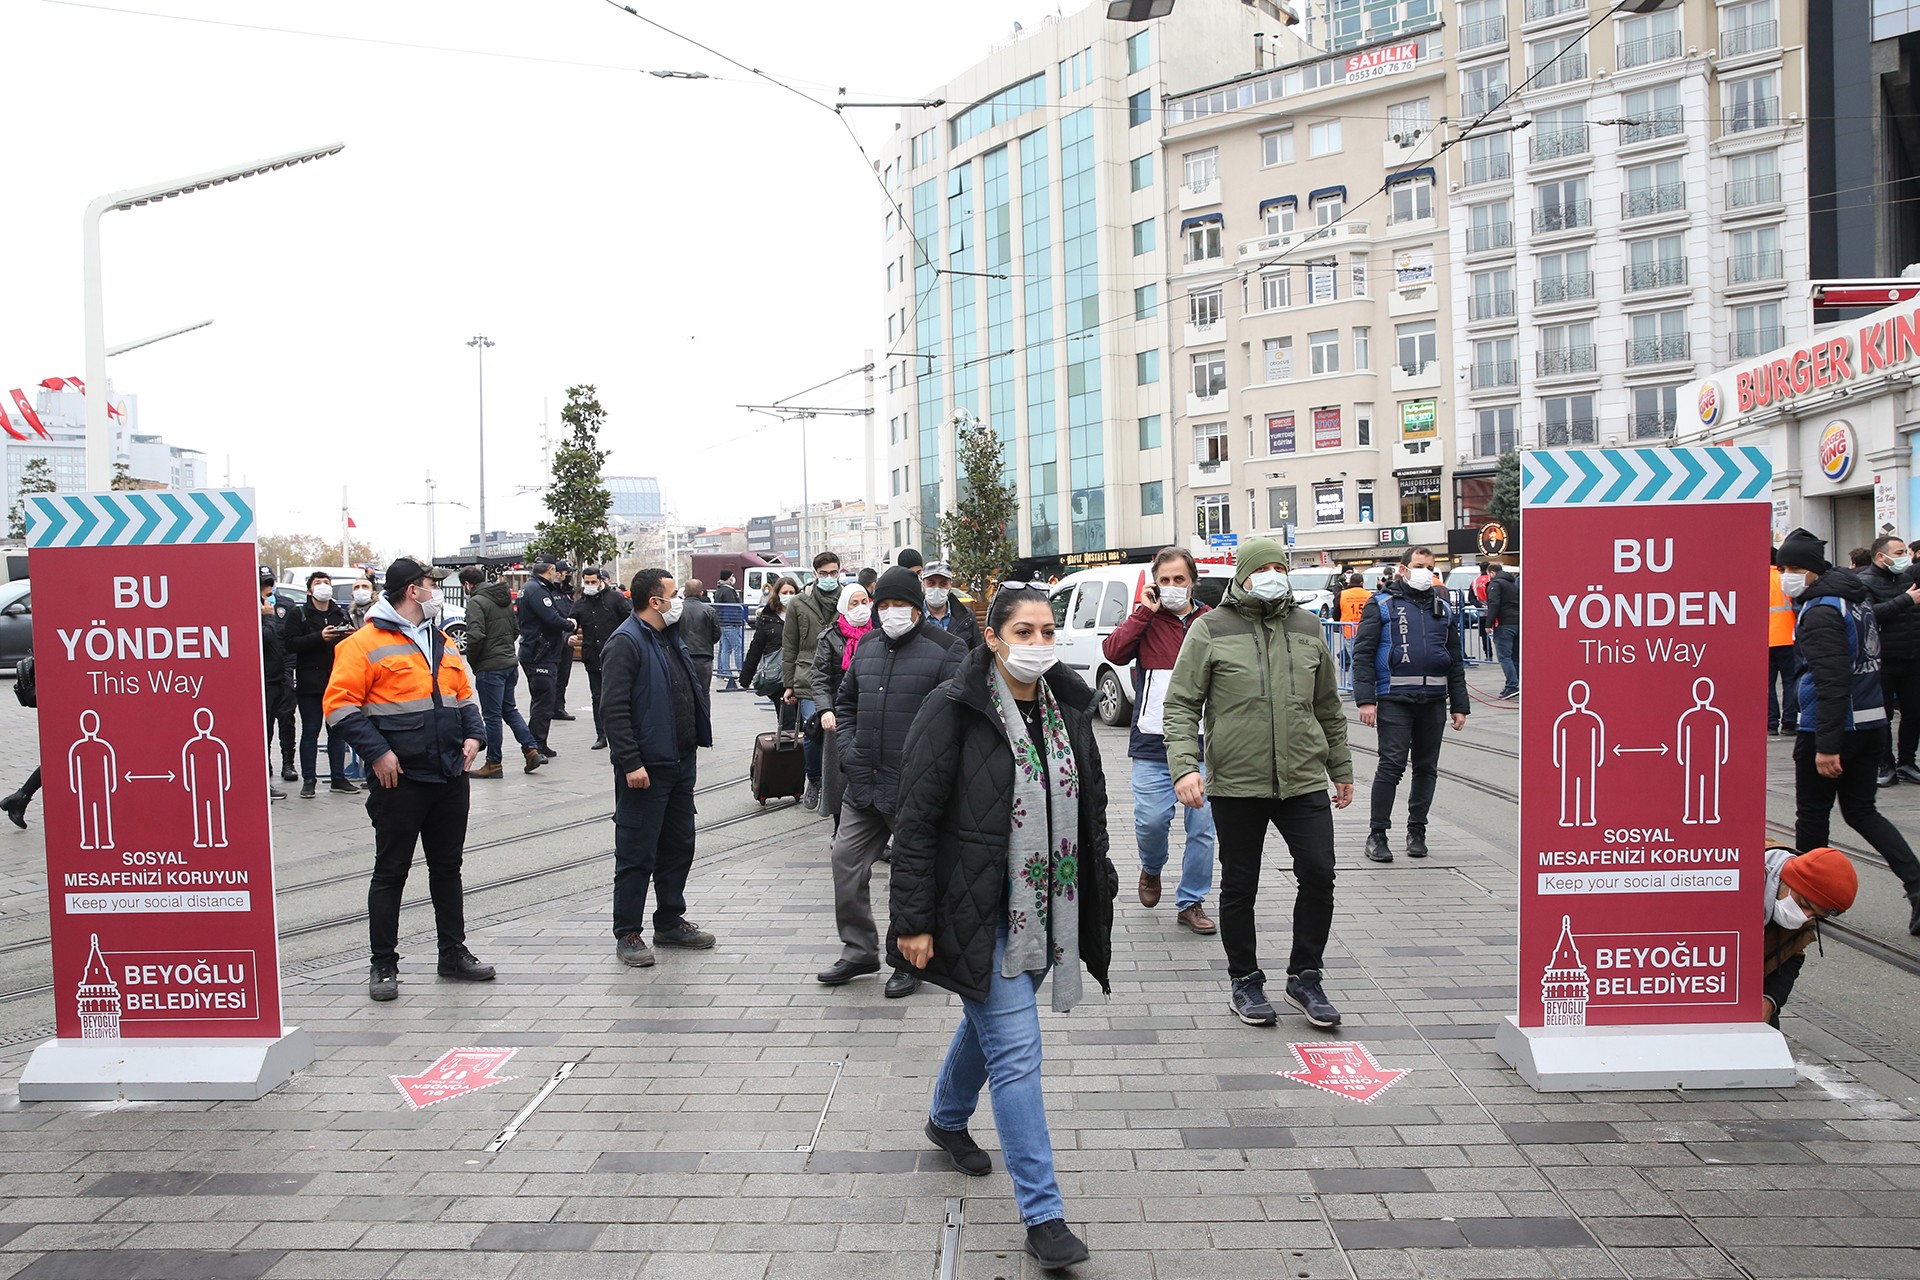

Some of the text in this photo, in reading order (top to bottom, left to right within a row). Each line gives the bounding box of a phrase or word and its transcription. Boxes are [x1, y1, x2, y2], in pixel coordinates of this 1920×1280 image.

[1349, 45, 1413, 70] SATILIK
[1349, 69, 1370, 82] 0553
[1389, 63, 1400, 73] 76
[1402, 61, 1412, 71] 76
[1736, 308, 1920, 413] BURGER KIN
[1822, 439, 1847, 466] KING
[1400, 478, 1441, 488] HAIRDRESSER
[1381, 531, 1390, 540] E
[1613, 537, 1674, 573] BU
[113, 575, 169, 609] BU
[1548, 584, 1737, 629] YÖNDEN
[56, 619, 230, 661] YÖNDEN
[1397, 606, 1411, 664] ZABITA
[1578, 637, 1707, 668] This Way
[86, 669, 204, 699] This Way
[1603, 828, 1675, 844] SOSYAL
[122, 851, 188, 866] SOSYAL
[1538, 846, 1740, 866] MESAFENİZİ KORUYUN
[64, 868, 249, 887] MESAFENİZİ KORUYUN
[1545, 873, 1733, 892] Keep your social distance
[72, 894, 244, 911] Keep your social distance
[1596, 941, 1727, 969] BEYOĞLU
[124, 958, 245, 985] BEYOĞLU
[1596, 971, 1726, 995] BELEDİYESİ
[126, 988, 247, 1010] BELEDİYESİ
[1546, 999, 1584, 1015] BEYOĞLU
[83, 1013, 118, 1028] BEYOĞLU
[1546, 1014, 1584, 1026] BELEDİYESİ
